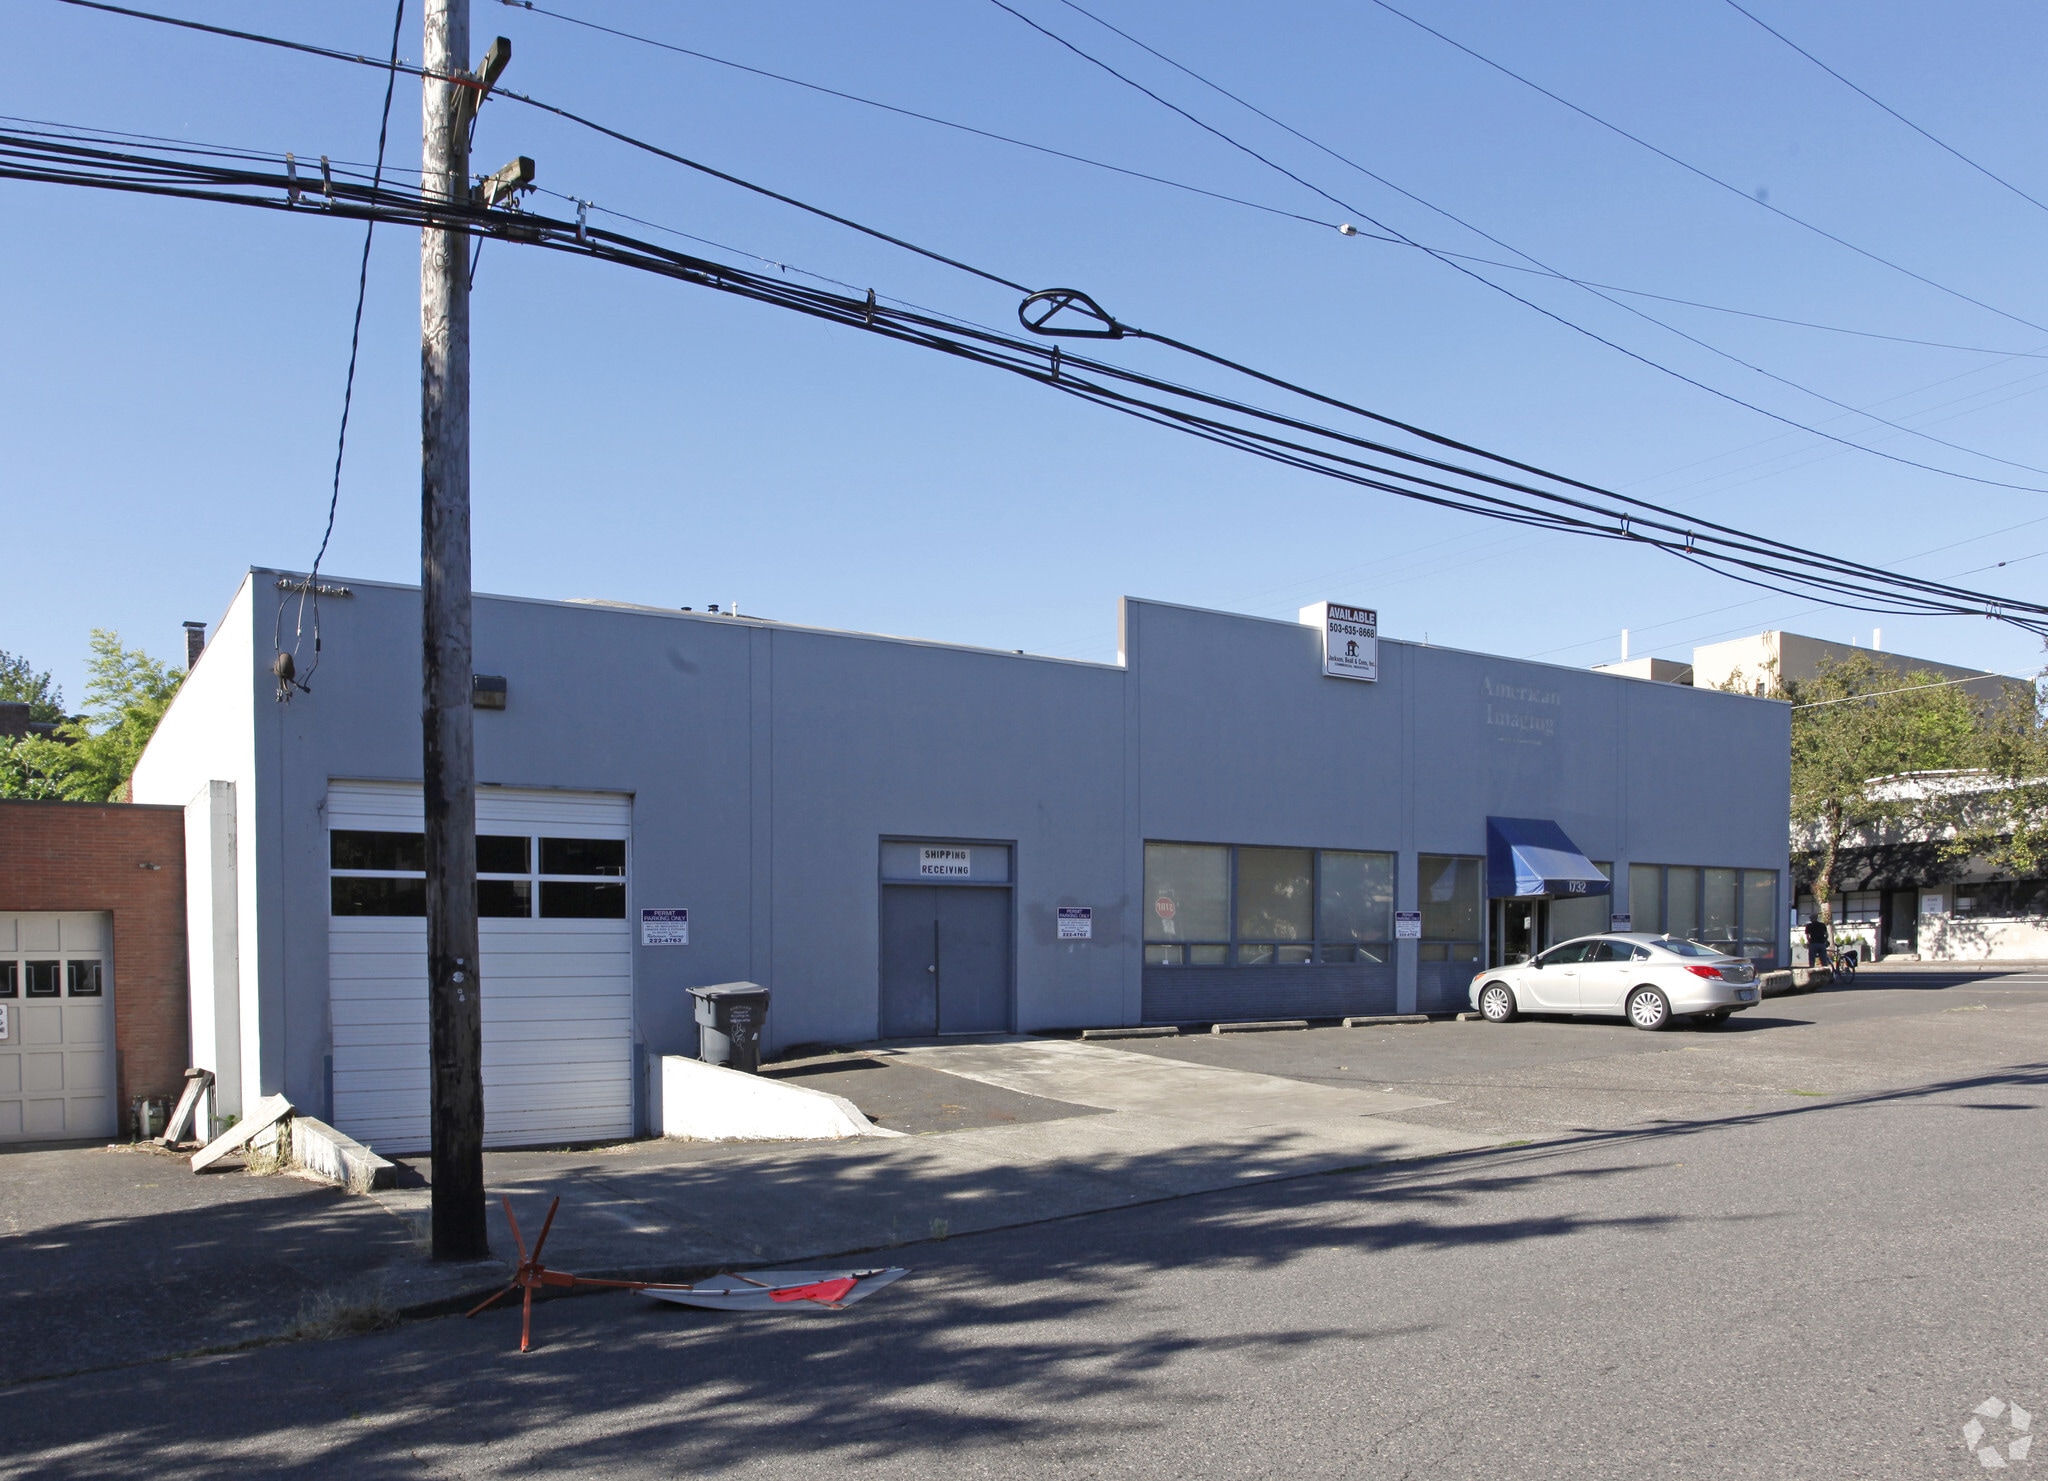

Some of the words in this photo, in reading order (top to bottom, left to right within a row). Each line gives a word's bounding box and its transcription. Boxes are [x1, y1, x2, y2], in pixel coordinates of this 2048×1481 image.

[1329, 606, 1375, 625] AVAILABLE
[1480, 676, 1561, 706] American
[1487, 703, 1554, 736] Imaging
[925, 850, 966, 860] SHIPPING
[922, 865, 968, 874] RECEIVING
[1569, 881, 1586, 893] 1732
